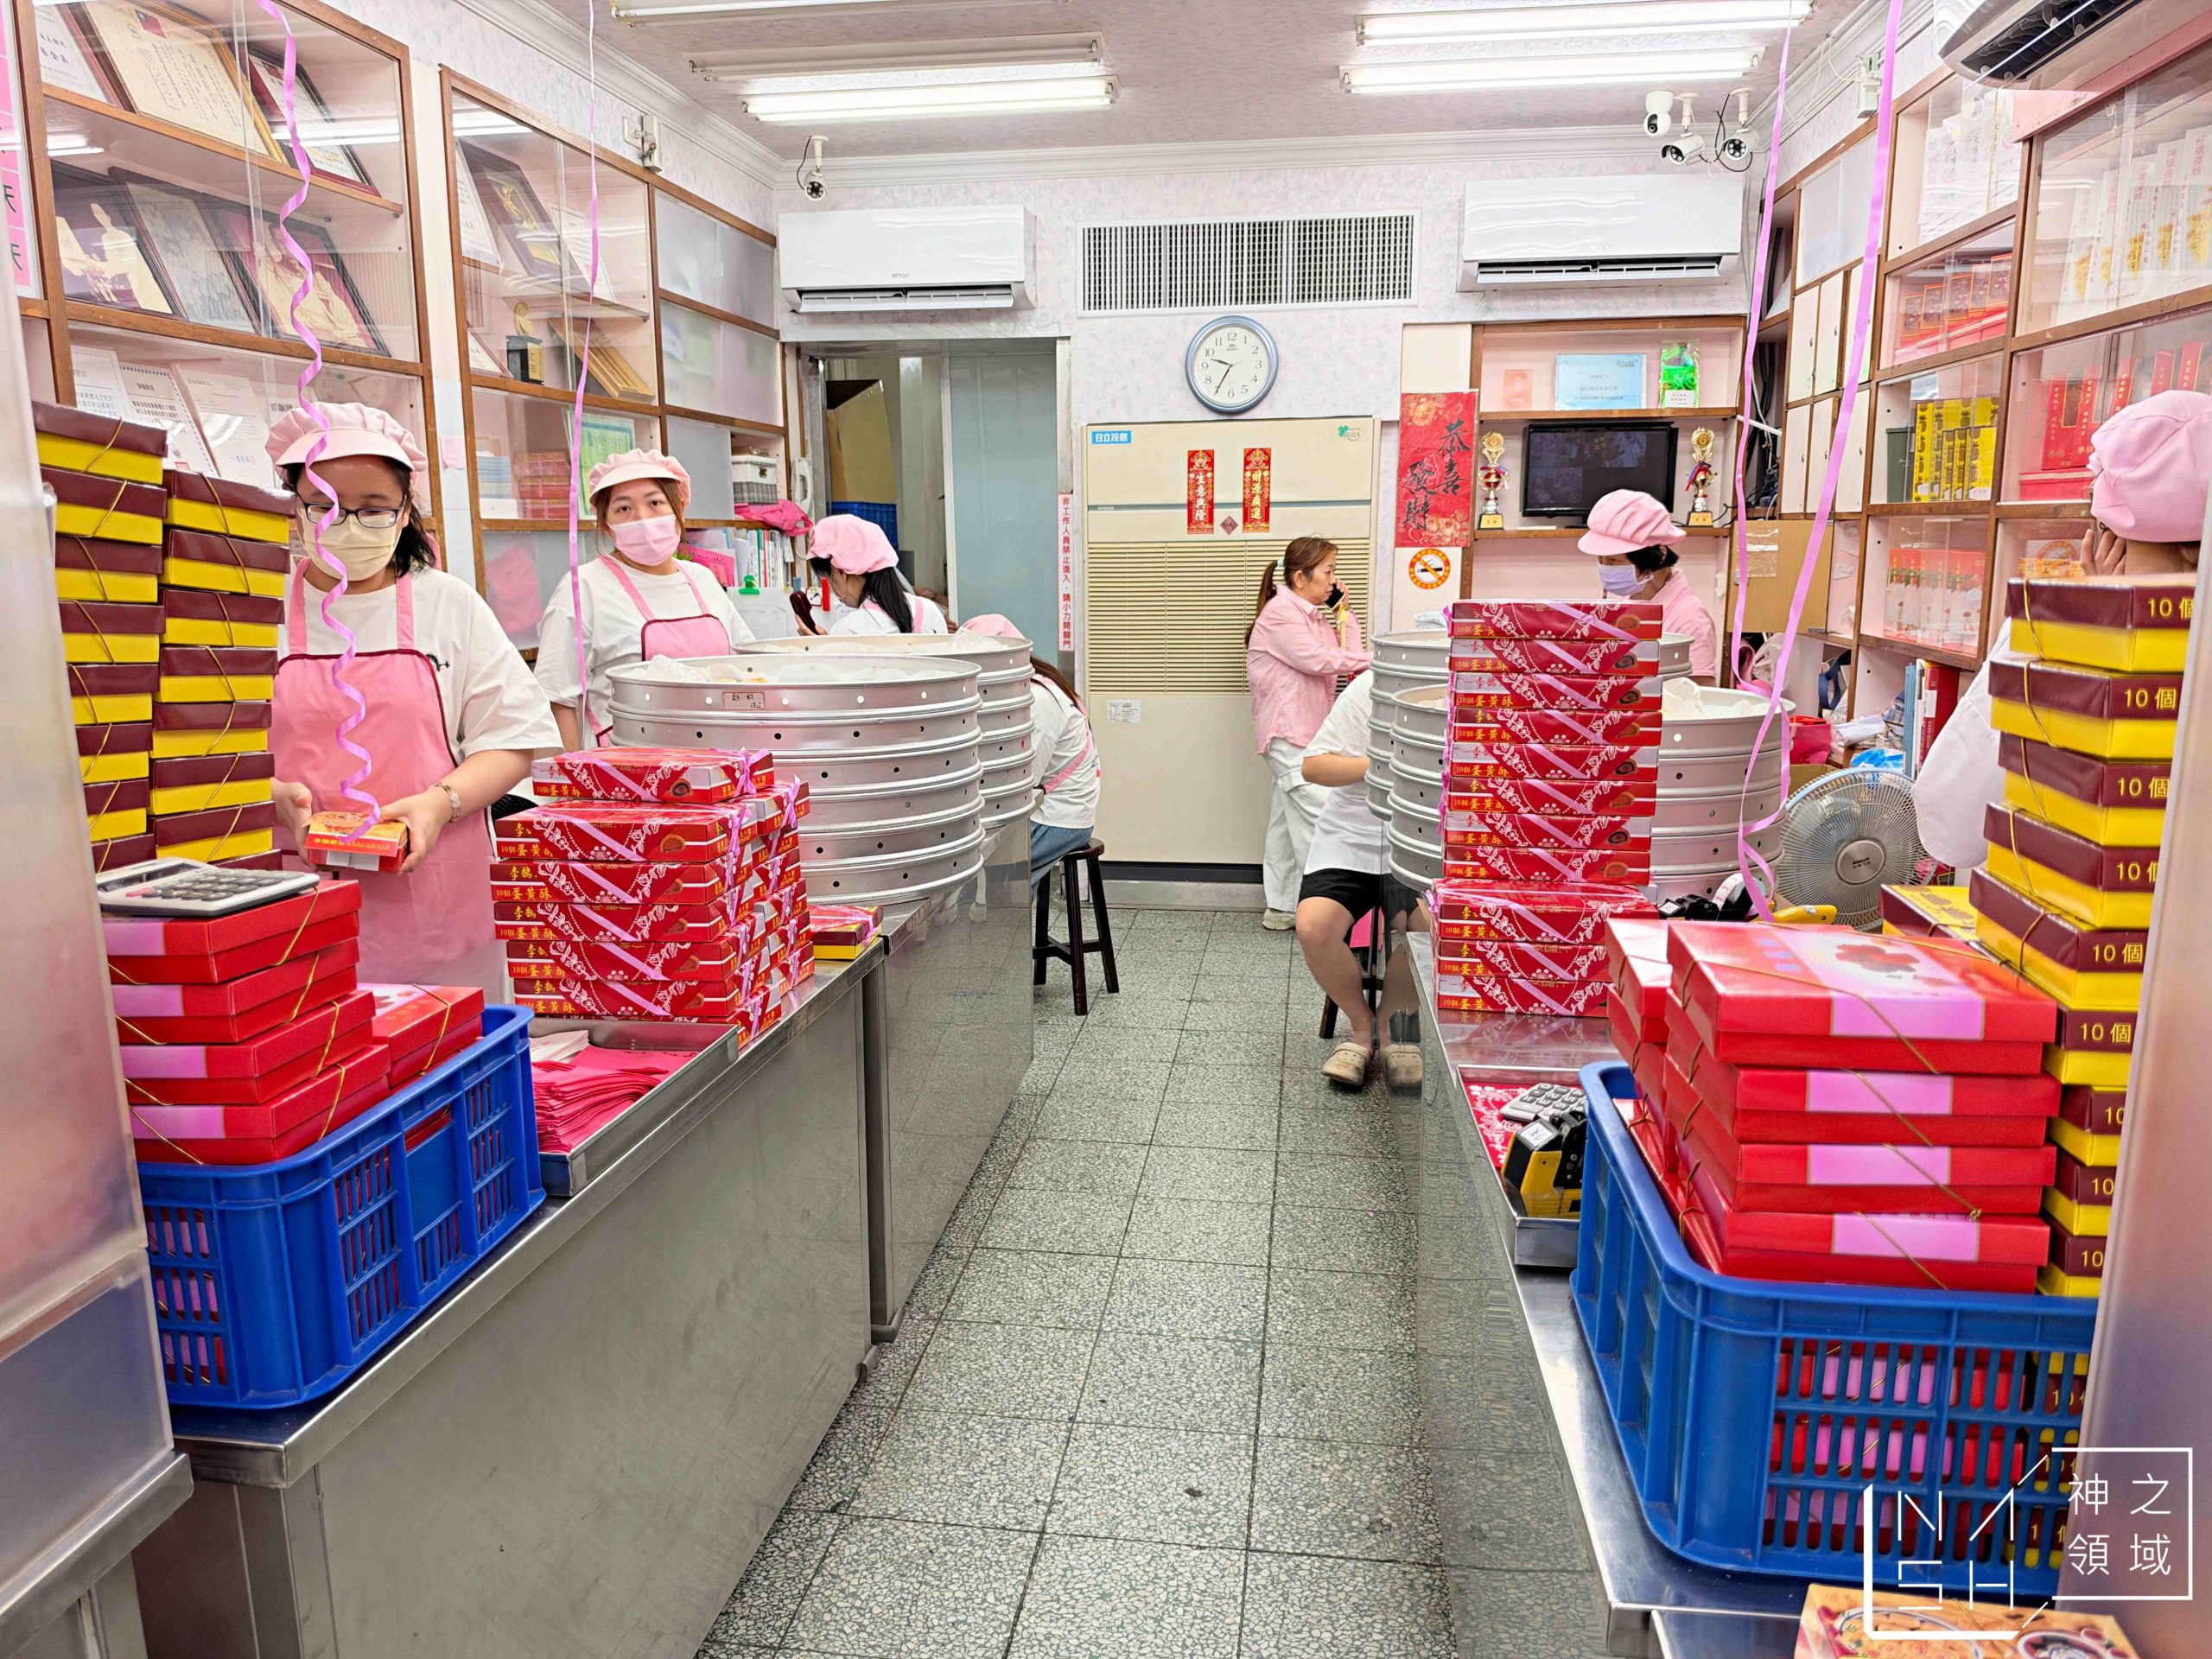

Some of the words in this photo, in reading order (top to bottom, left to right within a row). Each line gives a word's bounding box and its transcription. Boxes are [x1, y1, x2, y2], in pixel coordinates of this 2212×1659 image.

[1215, 337, 1223, 346] 11
[1227, 333, 1237, 341] 12
[1205, 348, 1215, 357] 10
[1252, 346, 1259, 354] 2
[1201, 362, 1209, 371] 9
[1255, 360, 1262, 369] 3
[1205, 375, 1212, 385] 8
[1227, 390, 1235, 398] 6
[1241, 385, 1248, 394] 5
[1436, 417, 1471, 496] 恭喜
[2148, 597, 2172, 619] 10
[2125, 688, 2148, 708] 10
[2155, 688, 2177, 709] 個
[2118, 777, 2142, 797] 10
[2149, 777, 2170, 798] 個
[2116, 862, 2140, 881] 10
[2093, 944, 2116, 963] 10
[2122, 944, 2143, 964] 個
[2081, 1022, 2104, 1041] 10
[2111, 1022, 2131, 1043] 個
[2105, 1107, 2126, 1125] 10
[2092, 1178, 2114, 1196] 10
[2082, 1249, 2104, 1268] 10
